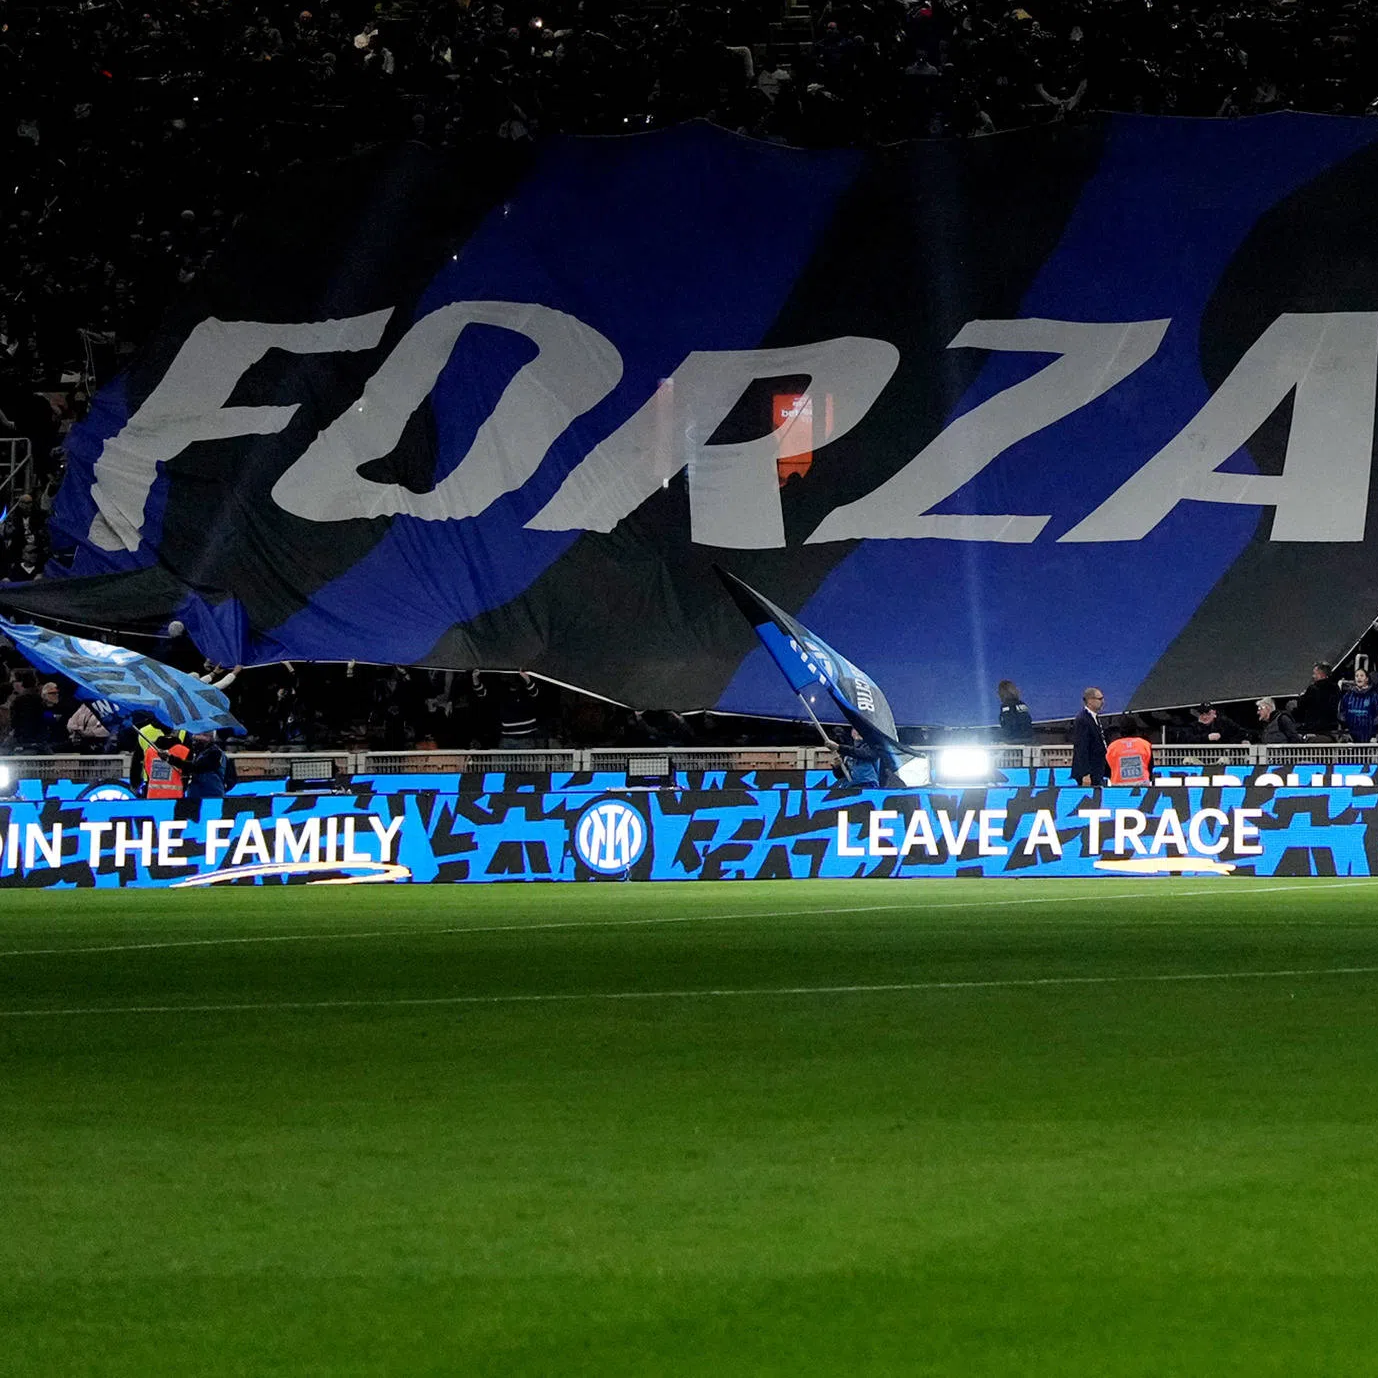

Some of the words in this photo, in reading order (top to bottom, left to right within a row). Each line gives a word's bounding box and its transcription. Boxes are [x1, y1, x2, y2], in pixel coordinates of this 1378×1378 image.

[79, 821, 188, 868] THE
[205, 814, 405, 865] FAMILY
[836, 809, 1008, 857] LEAVE
[1023, 810, 1063, 856] A
[1079, 807, 1264, 856] TRACE
